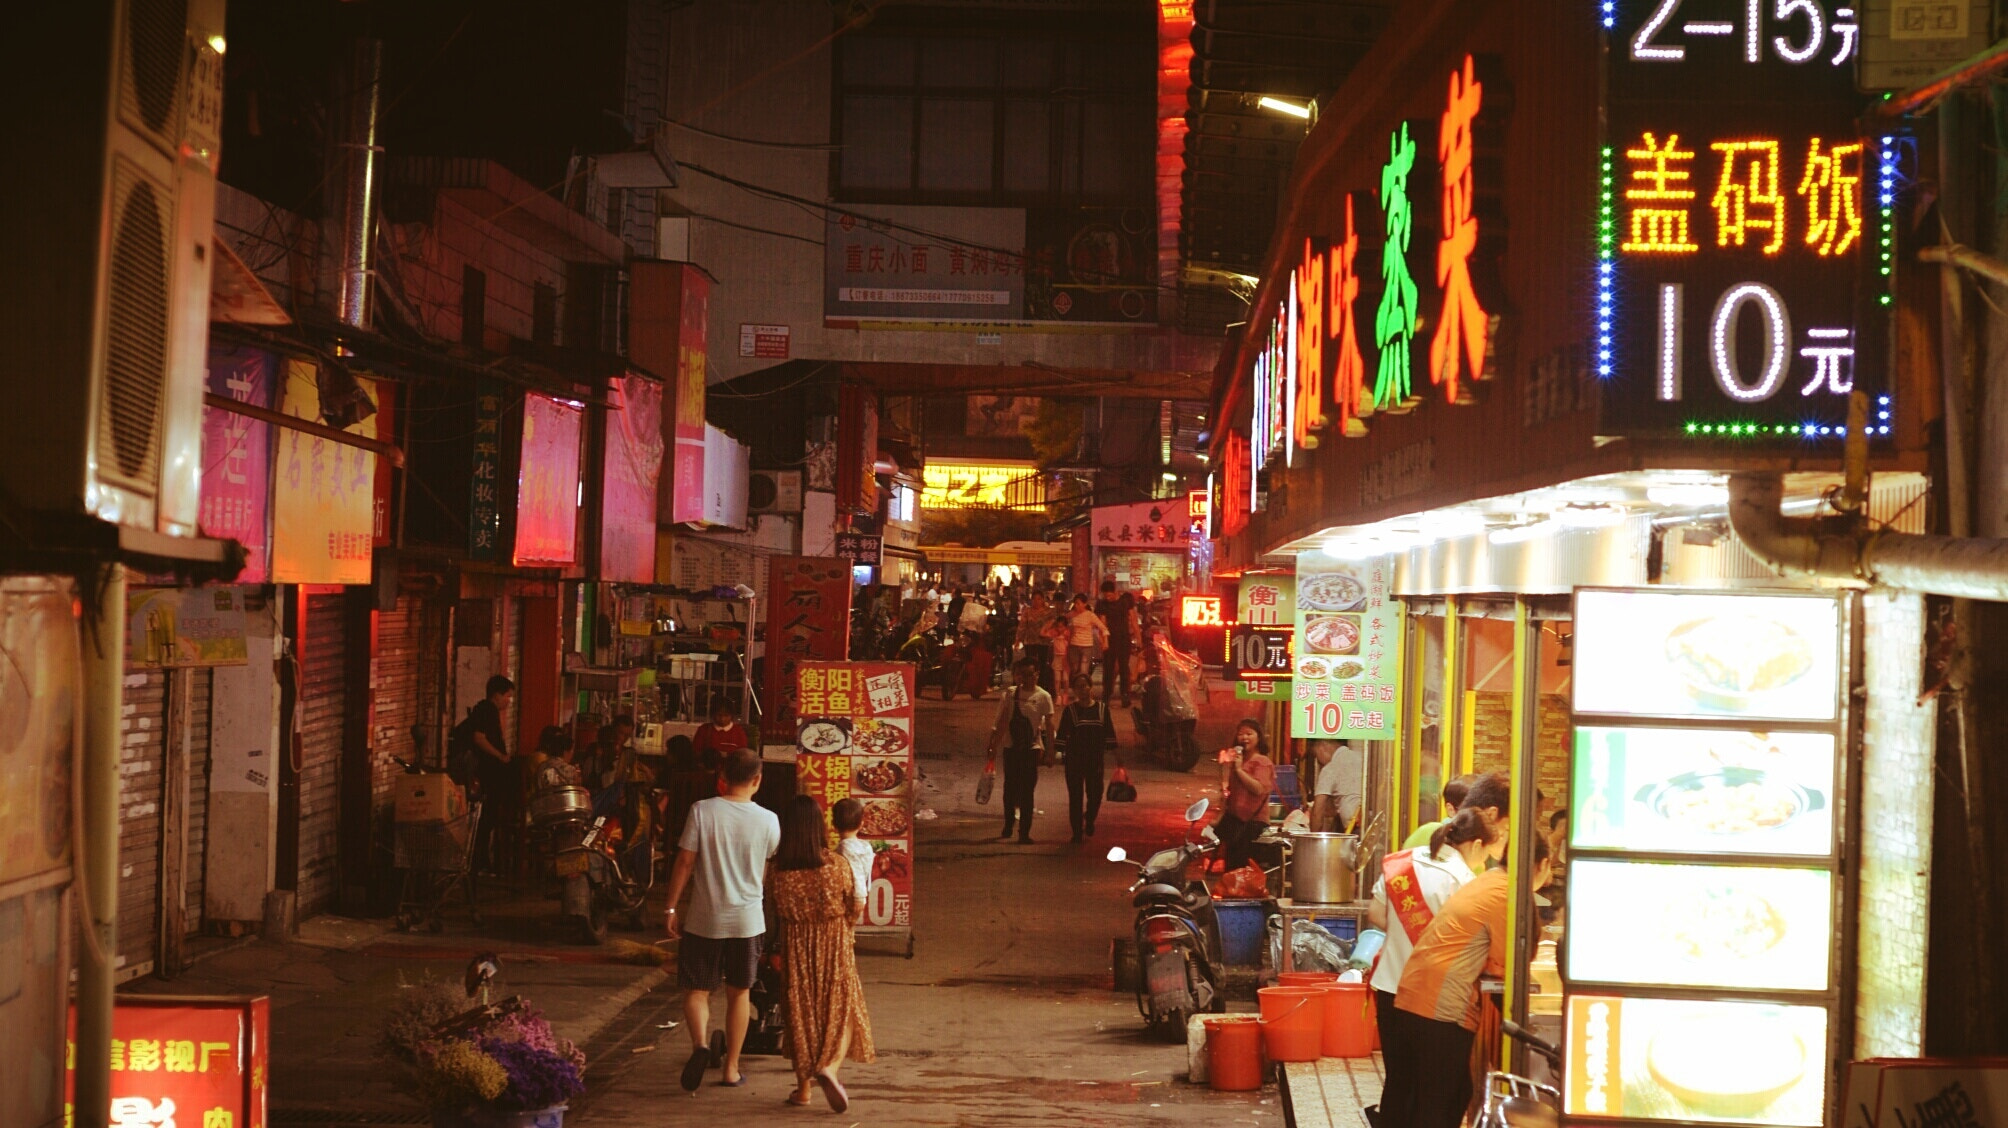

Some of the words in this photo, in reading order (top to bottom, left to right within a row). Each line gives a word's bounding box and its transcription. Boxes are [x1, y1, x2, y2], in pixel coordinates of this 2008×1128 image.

[1621, 132, 1863, 257] 盖码饭
[844, 244, 929, 275] 重庆小面
[1657, 282, 1856, 402] 10元
[838, 536, 879, 550] 米粉
[1232, 633, 1286, 670] 10元
[799, 668, 852, 691] 衡阳
[1294, 682, 1331, 701] 炒菜
[1340, 682, 1396, 703] 盖码饭
[799, 691, 852, 715] 活鱼
[1303, 702, 1342, 735] 10
[1347, 710, 1385, 730] 元起
[797, 755, 851, 780] 火锅
